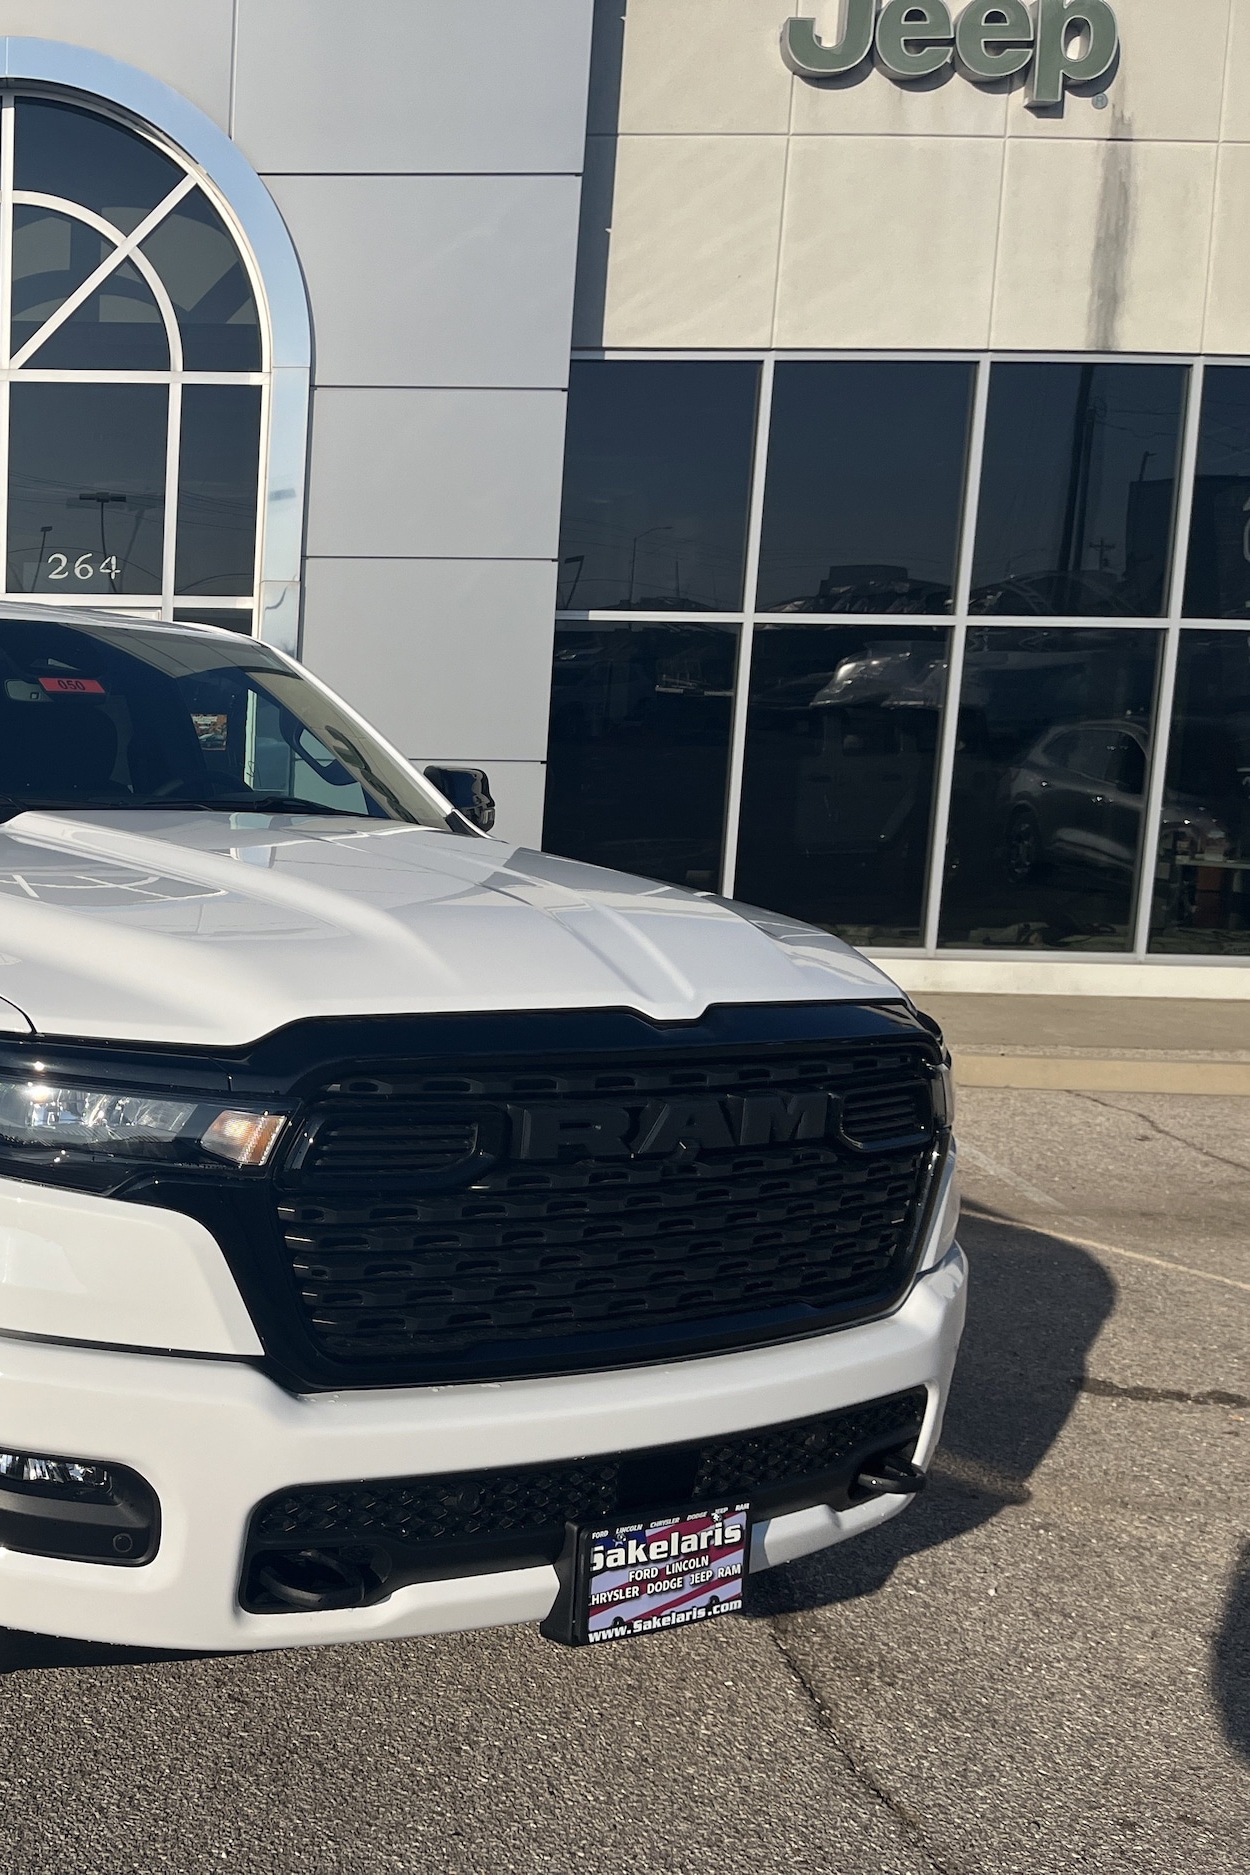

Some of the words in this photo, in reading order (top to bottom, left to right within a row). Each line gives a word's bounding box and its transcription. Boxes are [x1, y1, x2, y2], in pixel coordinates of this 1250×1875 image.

[784, 0, 1119, 104] Jeep
[47, 553, 121, 580] 264
[57, 679, 86, 691] 050
[507, 1090, 829, 1160] RAM
[592, 1530, 609, 1539] FORD
[615, 1524, 643, 1534] LINCOLN
[650, 1517, 680, 1528] CHRYSLER
[686, 1511, 708, 1521] DODGE
[735, 1503, 750, 1511] RAM
[589, 1586, 640, 1606] HRYSLER
[647, 1579, 683, 1595] DODGE
[689, 1570, 713, 1585] JEEP
[718, 1564, 741, 1578] RAM
[629, 1567, 658, 1582] FORD
[666, 1555, 709, 1576] LINCOLN
